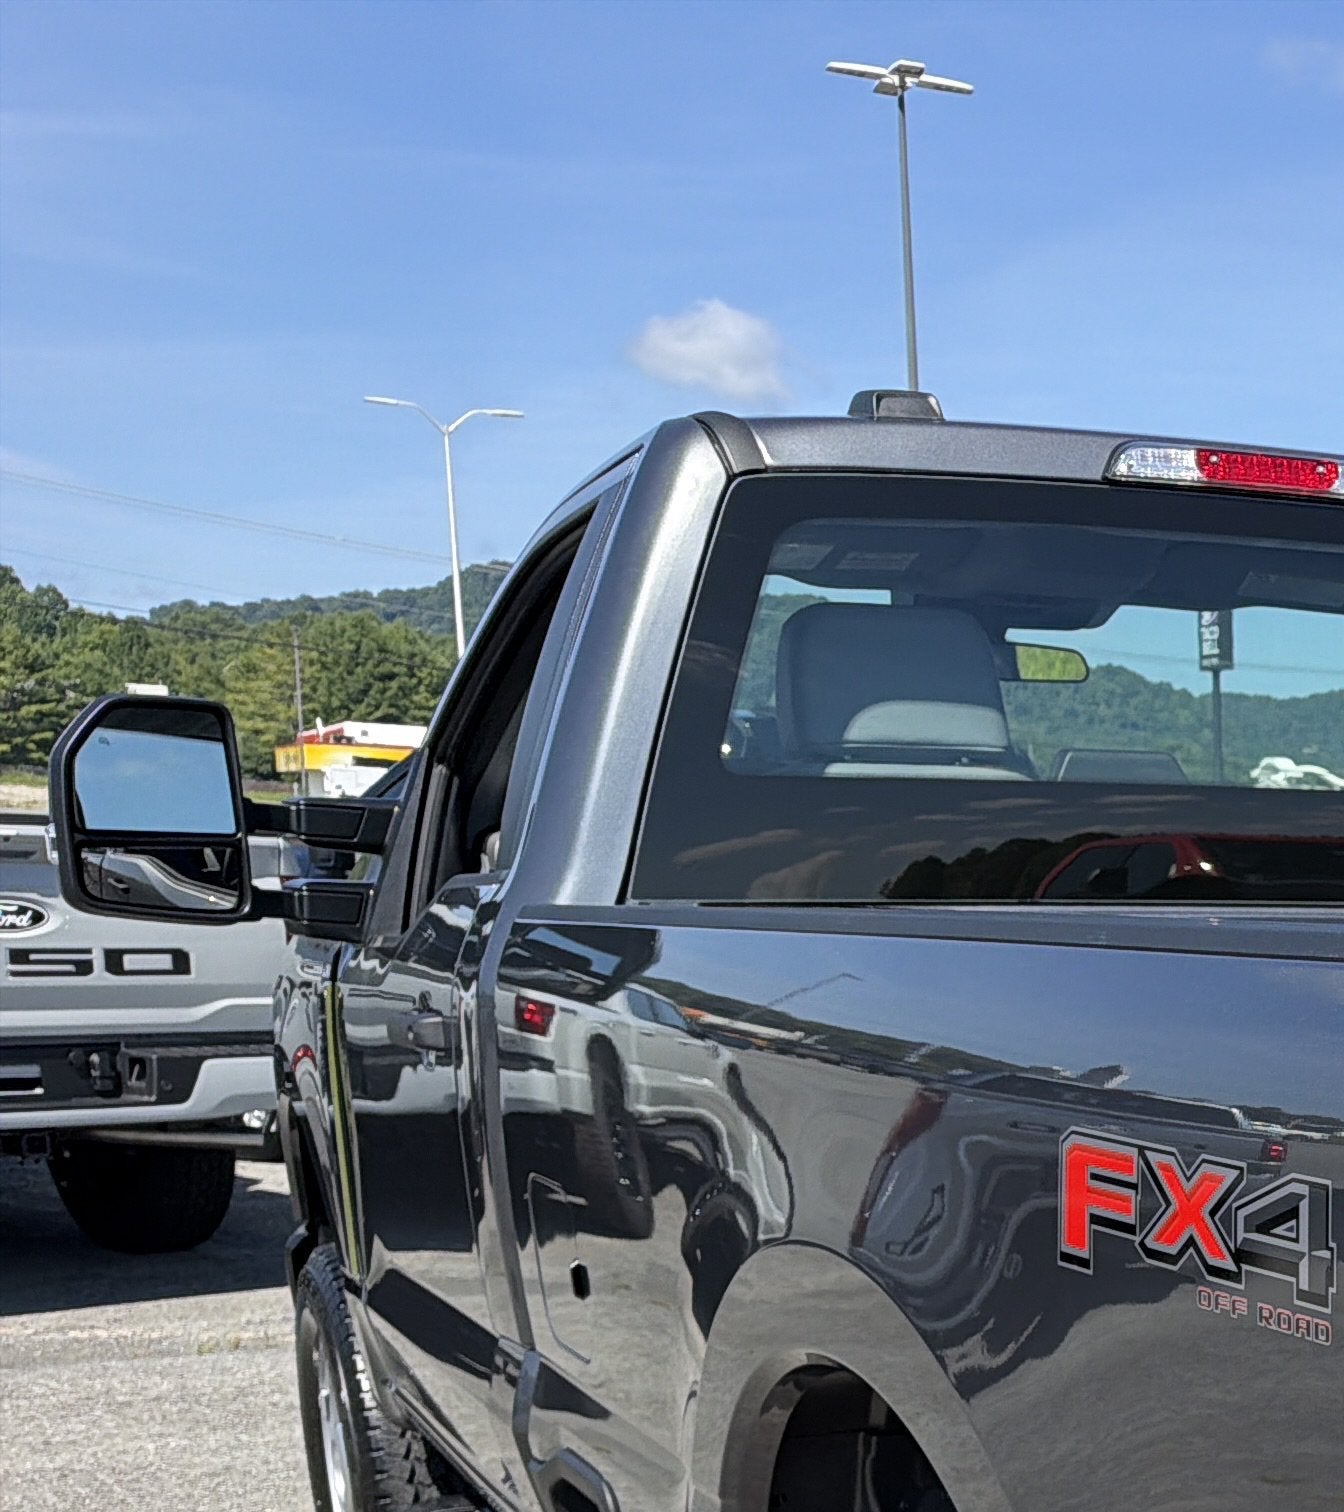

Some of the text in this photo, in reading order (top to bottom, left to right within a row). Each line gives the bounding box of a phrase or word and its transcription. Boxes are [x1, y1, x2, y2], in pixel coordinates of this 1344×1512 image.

[1057, 1126, 1337, 1314] FX4
[1196, 1286, 1333, 1346] OFF ROAD
